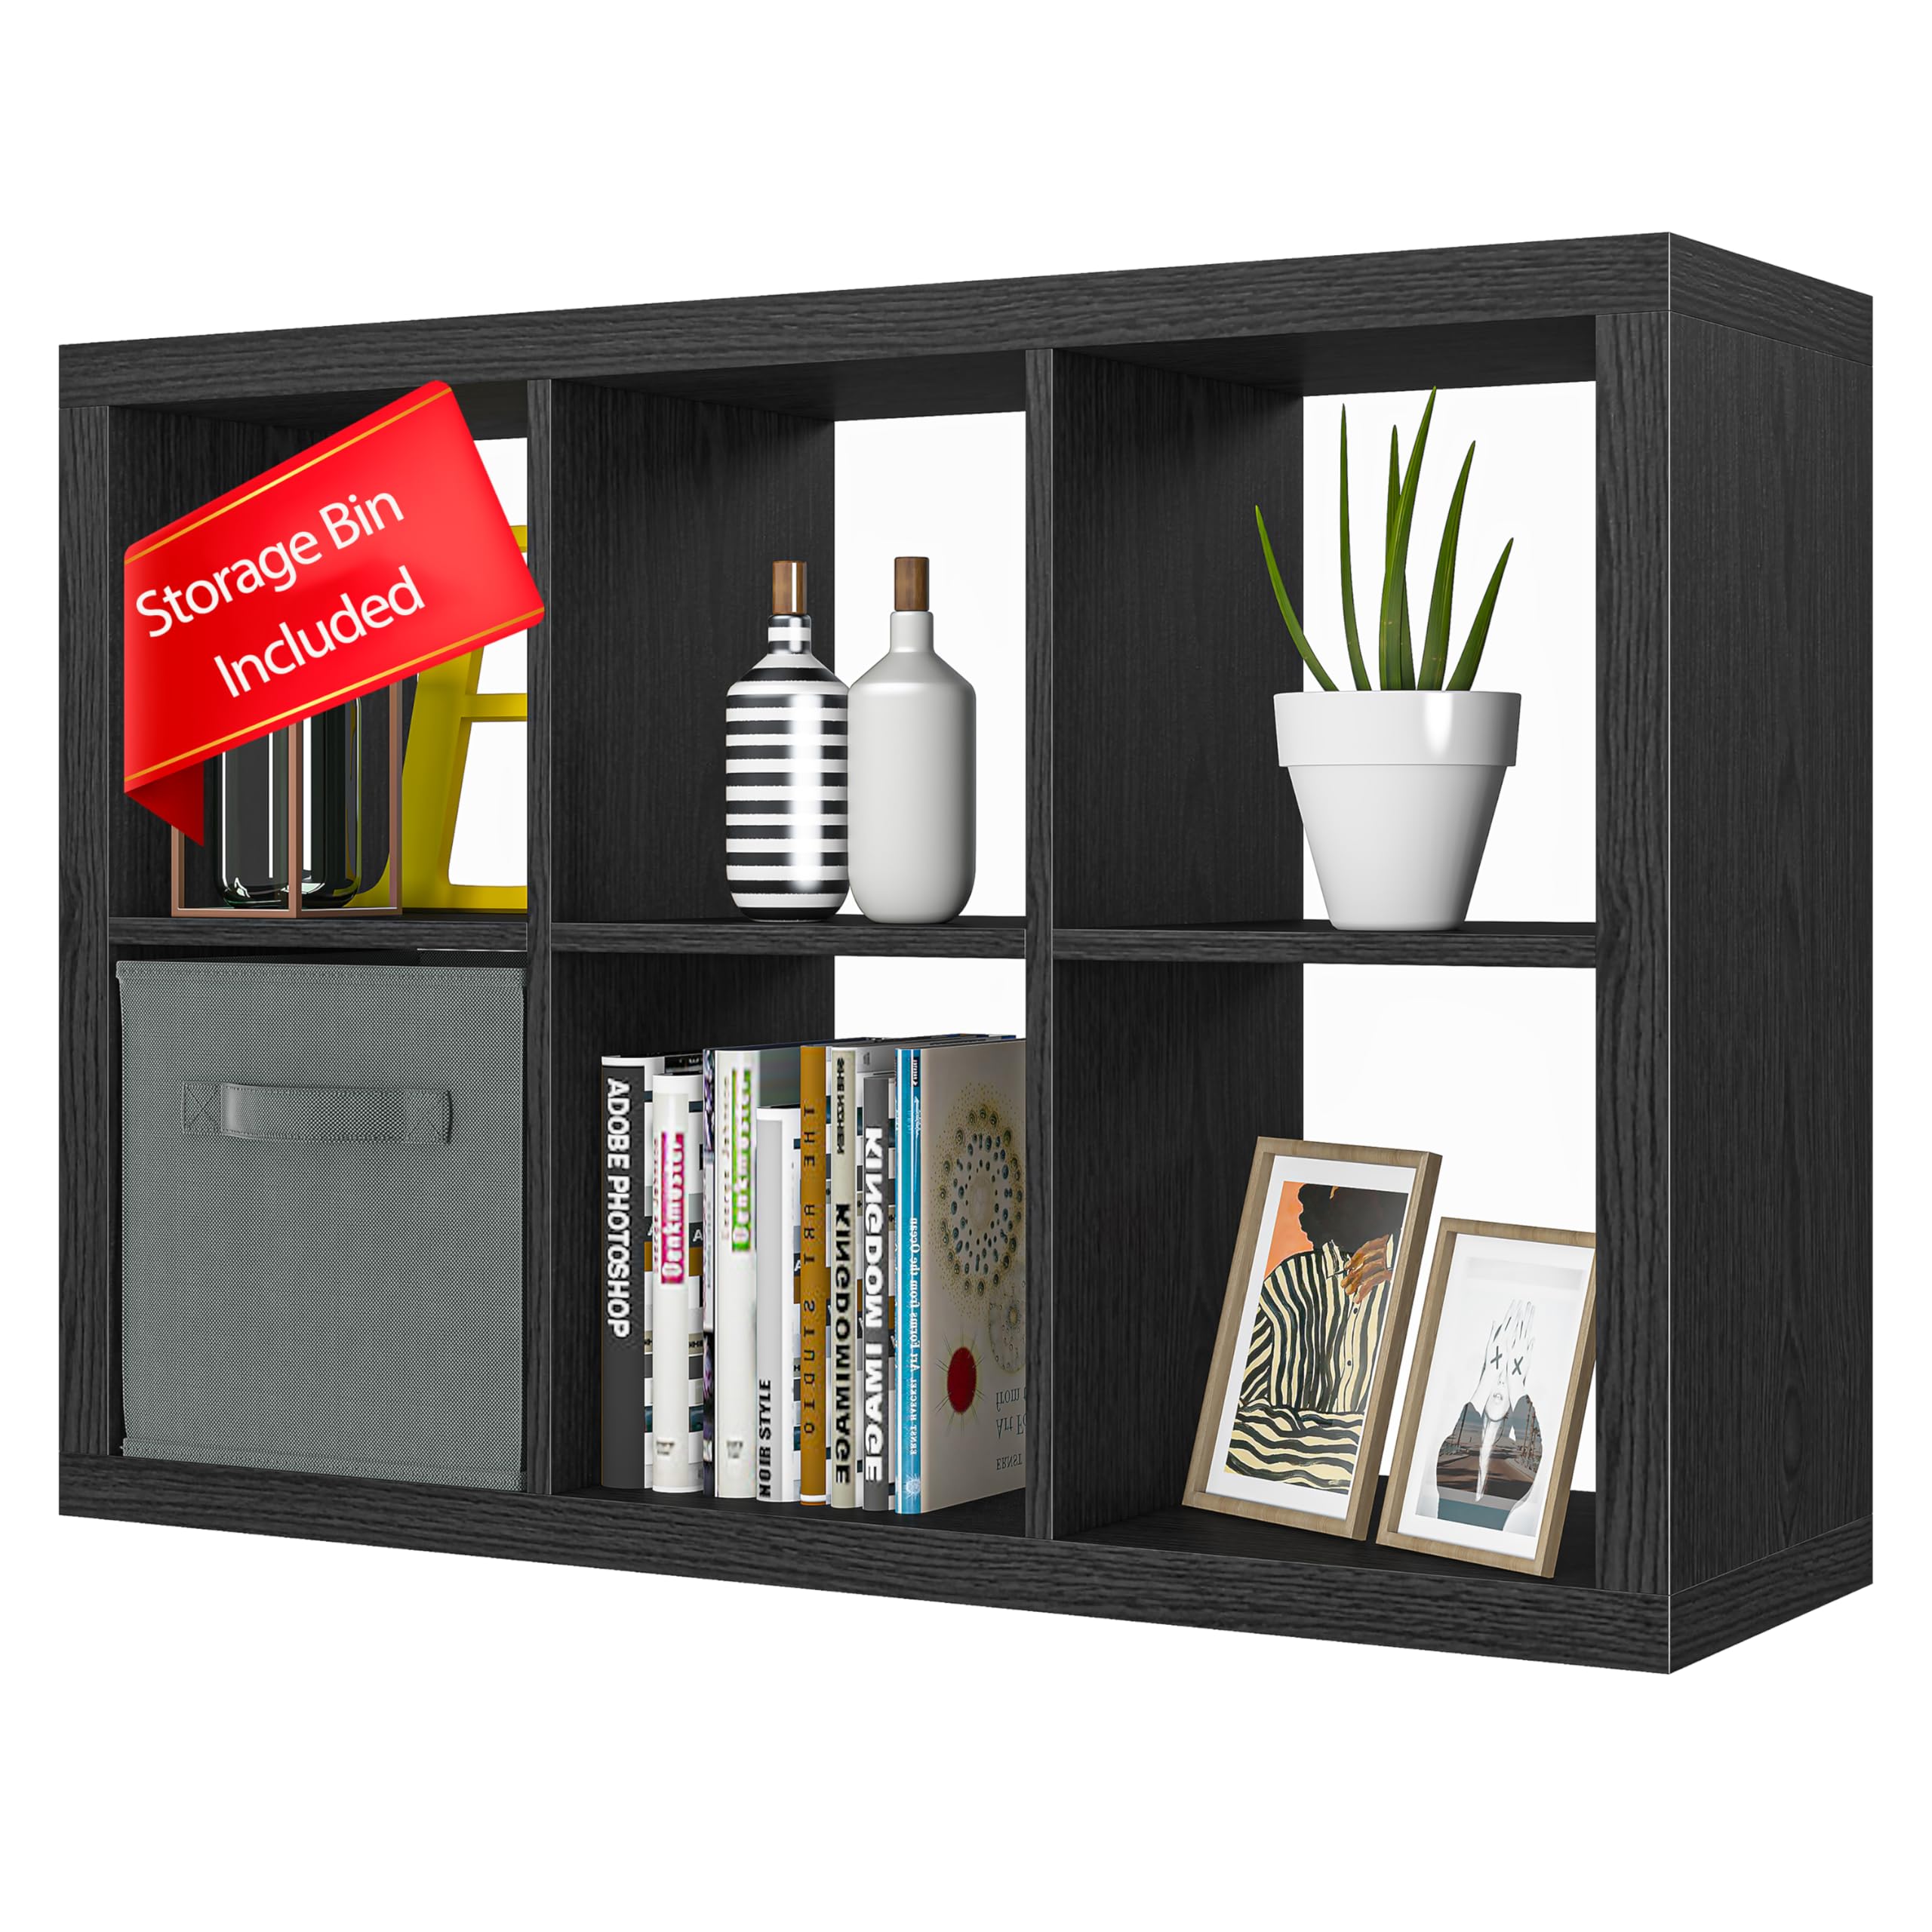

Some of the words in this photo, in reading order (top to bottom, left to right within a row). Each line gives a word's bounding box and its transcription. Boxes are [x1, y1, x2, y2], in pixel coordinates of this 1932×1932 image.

[607, 1078, 630, 1170] ADOBE
[607, 1175, 630, 1338] PHOTOSHOP
[758, 1379, 771, 1440] STYLE
[758, 1447, 771, 1498] NOIR
